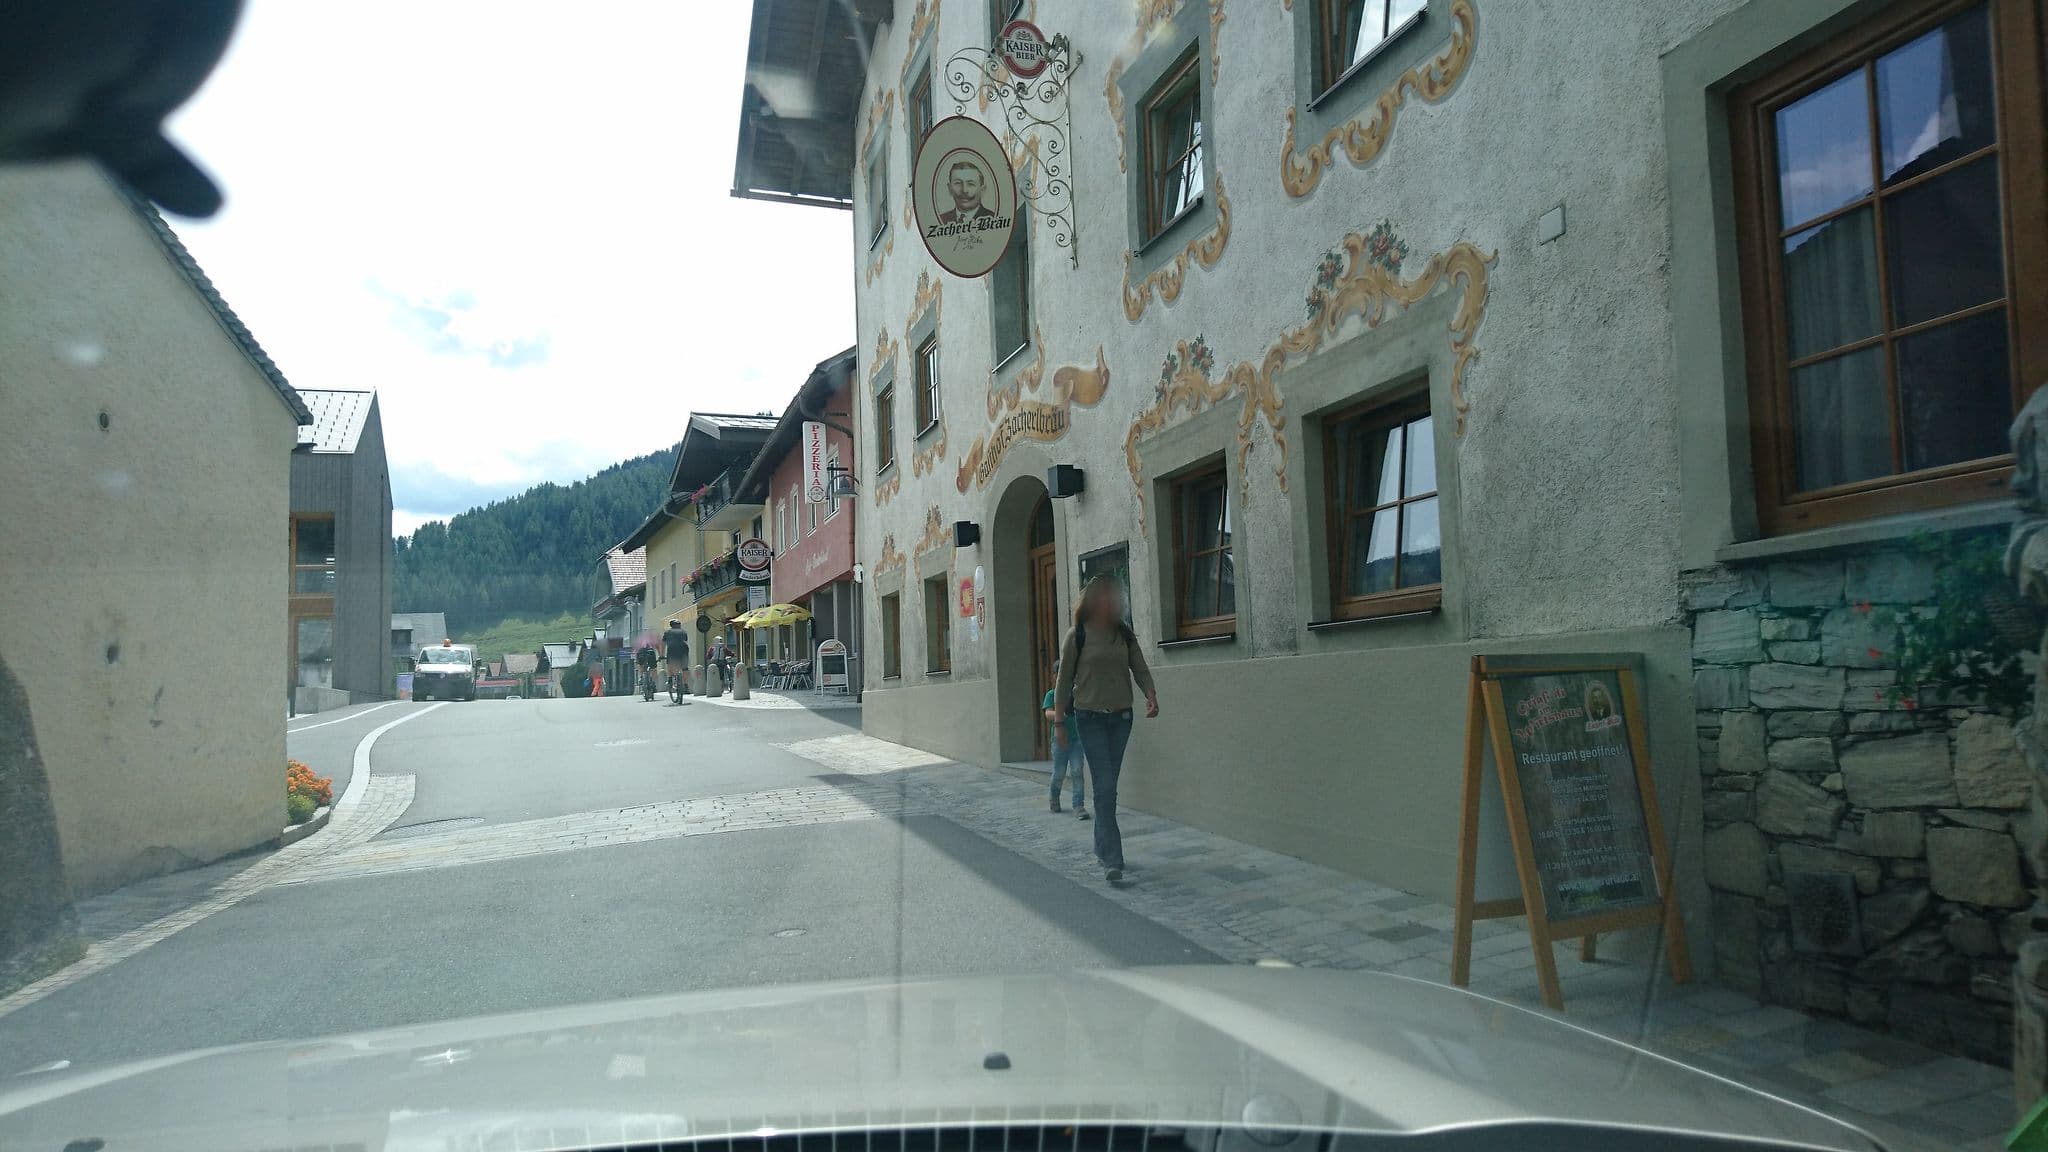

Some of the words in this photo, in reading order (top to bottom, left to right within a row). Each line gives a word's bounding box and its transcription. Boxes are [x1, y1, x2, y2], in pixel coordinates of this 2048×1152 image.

[1005, 40, 1044, 56] KAISER
[1016, 52, 1036, 60] BIER
[926, 216, 1011, 239] Zacherl-Bräu
[811, 424, 821, 486] PIZZERIA
[741, 549, 768, 557] KAISER
[1521, 749, 1578, 765] Restaurant
[1579, 743, 1623, 761] geöffnet!
